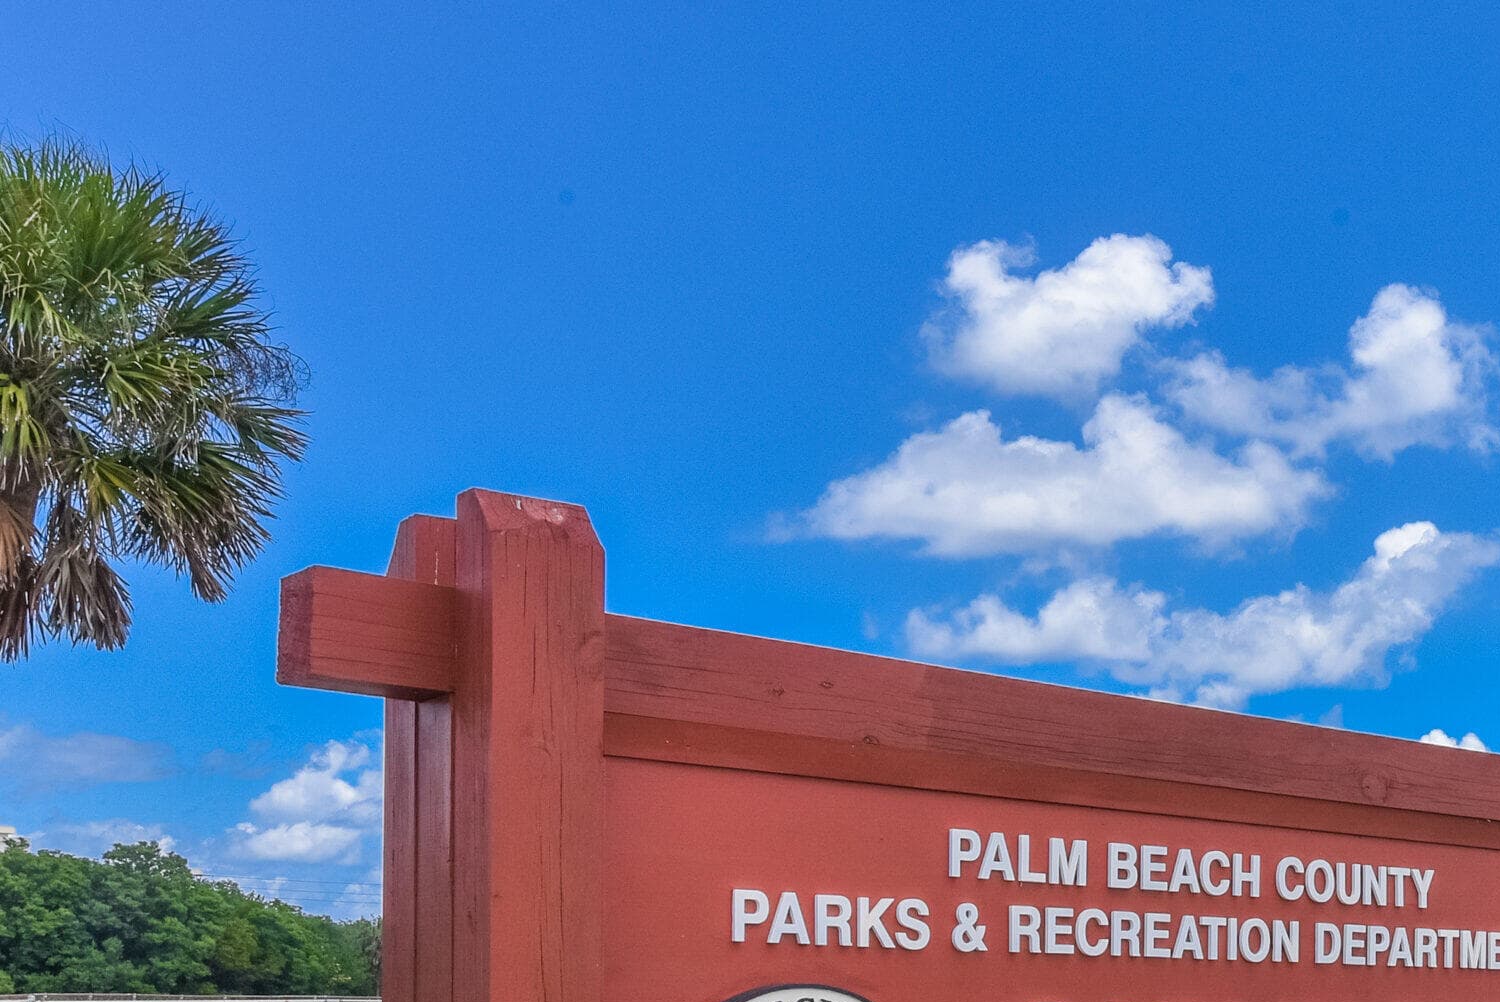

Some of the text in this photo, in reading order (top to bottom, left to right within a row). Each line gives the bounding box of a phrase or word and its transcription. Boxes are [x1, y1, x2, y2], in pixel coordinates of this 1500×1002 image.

[948, 828, 1435, 909] PALM BEACH COUNTY
[731, 889, 931, 951] PARKS
[951, 901, 987, 953] &
[1008, 905, 1300, 963] RECREATION
